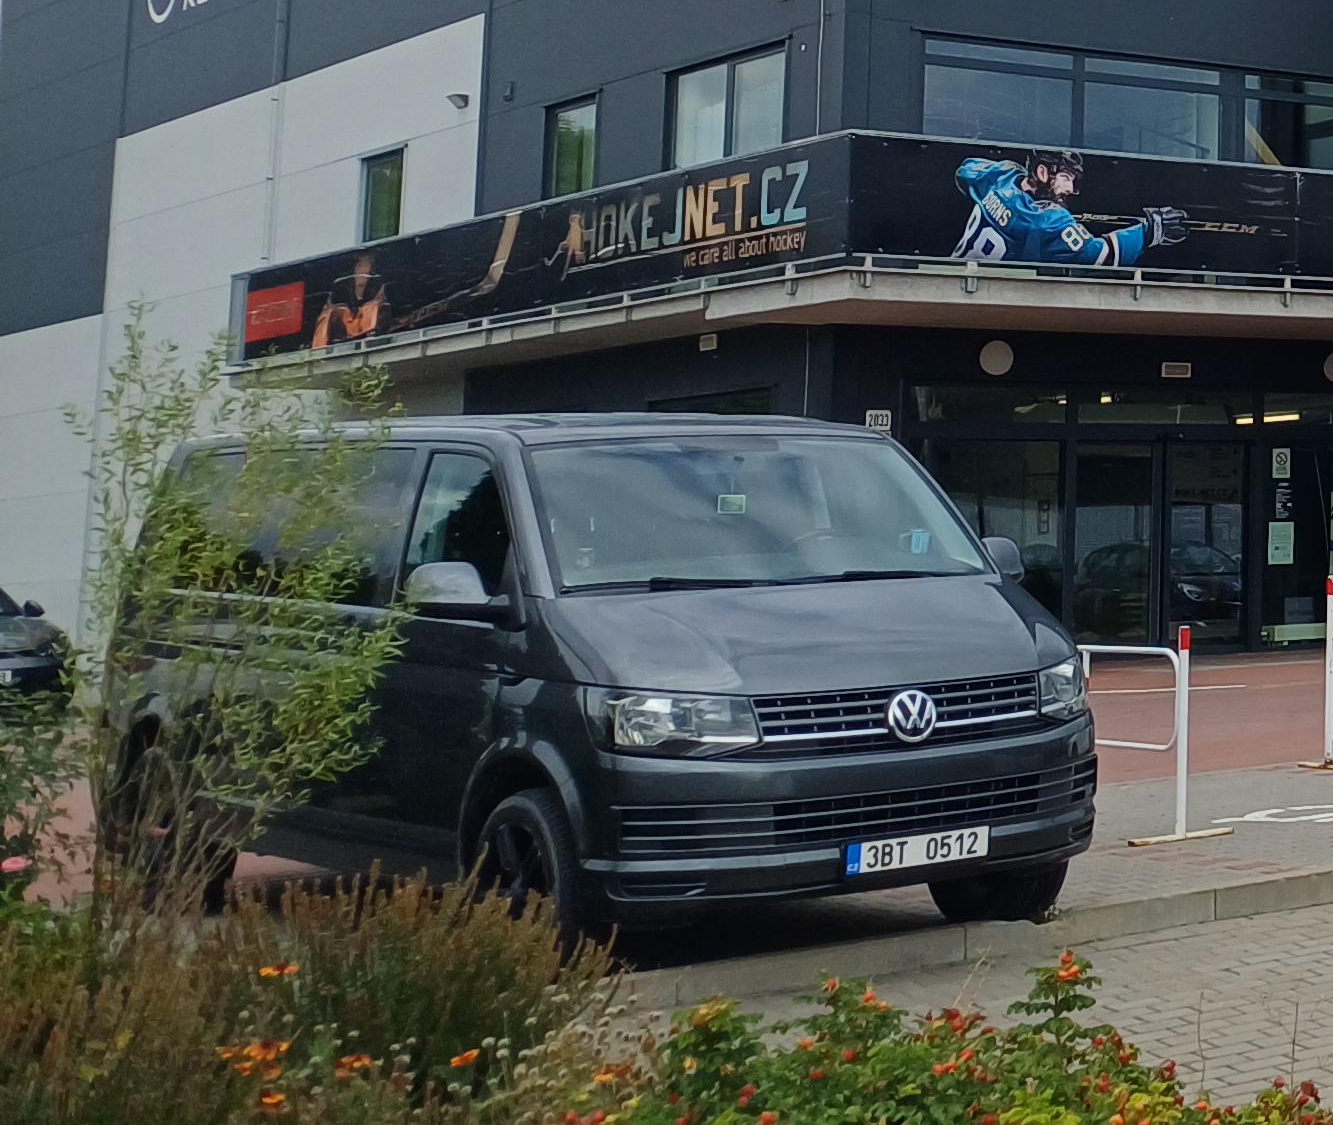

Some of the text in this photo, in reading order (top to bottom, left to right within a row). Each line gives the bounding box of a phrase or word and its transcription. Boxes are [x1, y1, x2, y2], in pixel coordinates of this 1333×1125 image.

[683, 230, 807, 268] we care all about hockey
[866, 840, 909, 868] 3BT
[926, 831, 979, 860] 0512
